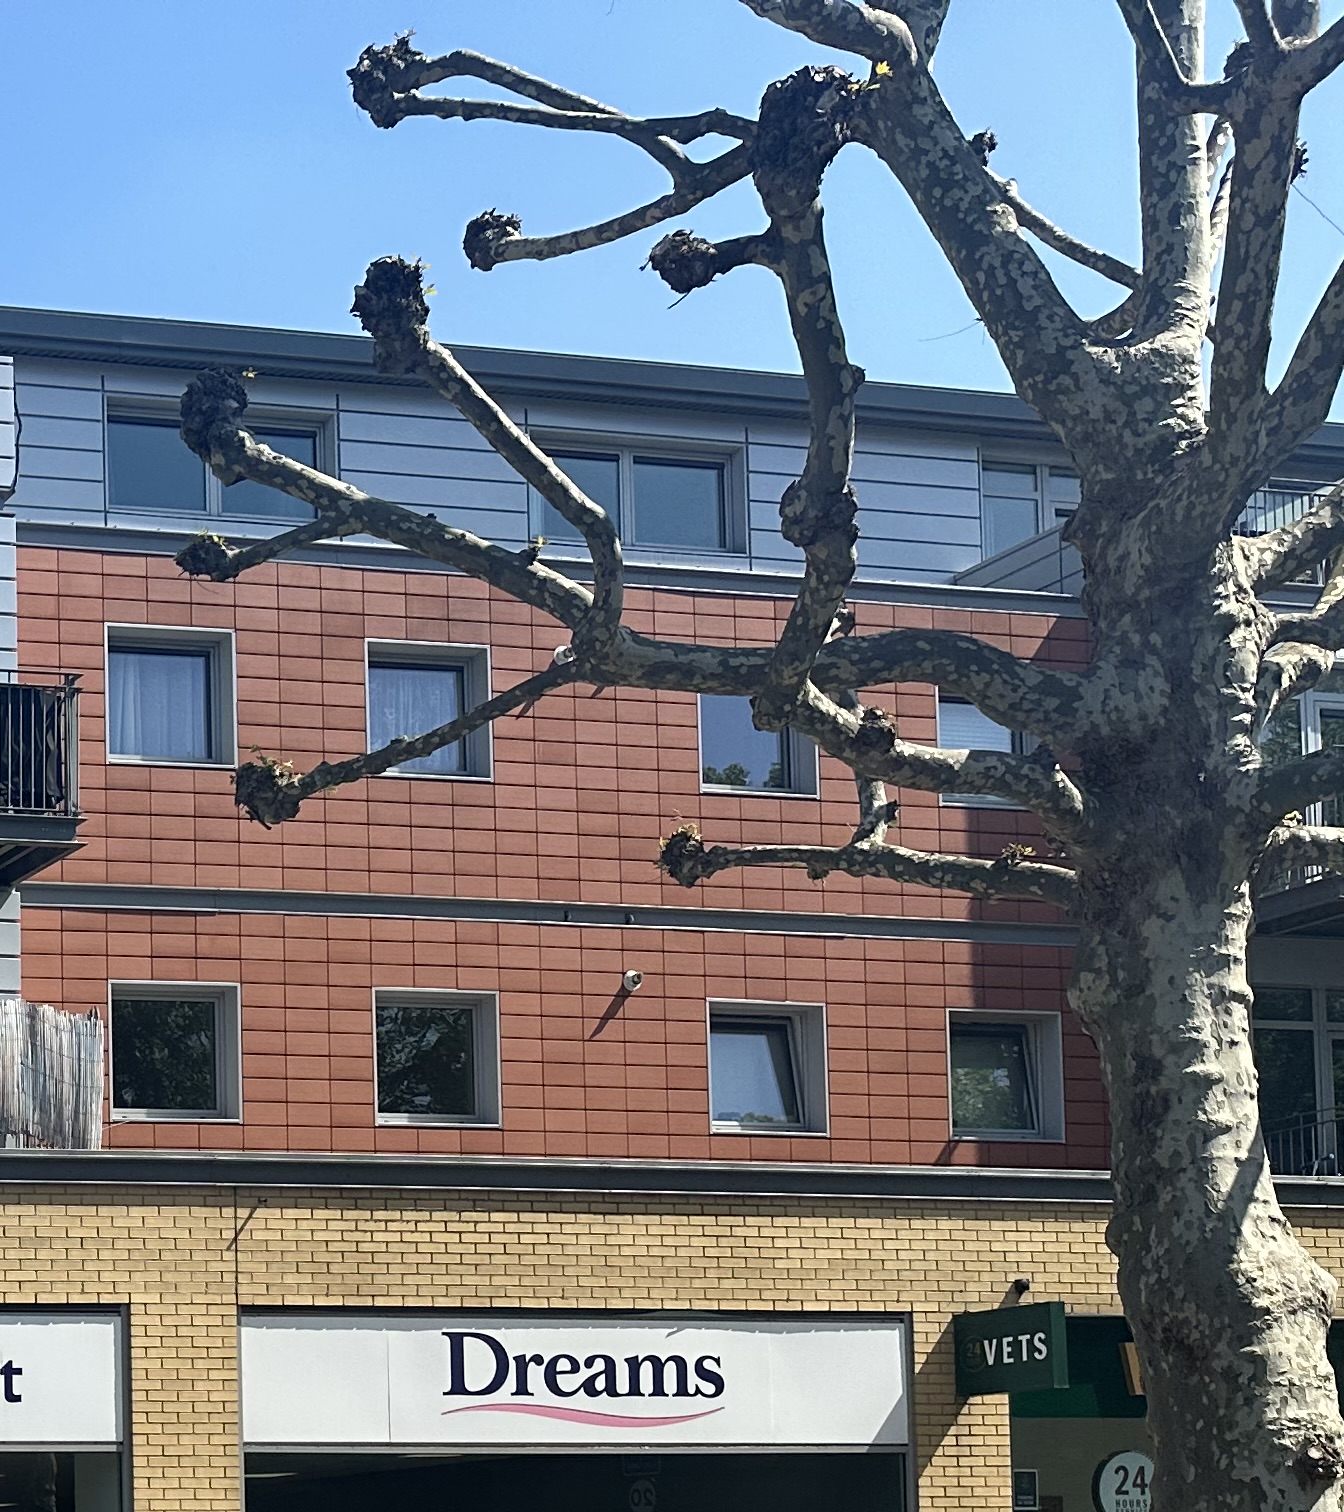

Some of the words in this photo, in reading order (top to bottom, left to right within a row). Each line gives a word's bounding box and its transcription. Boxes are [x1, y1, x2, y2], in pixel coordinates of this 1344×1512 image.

[442, 1330, 726, 1399] Dreams
[983, 1332, 1048, 1366] VETS
[1114, 1465, 1149, 1496] 24
[1115, 1499, 1148, 1509] HOURS
